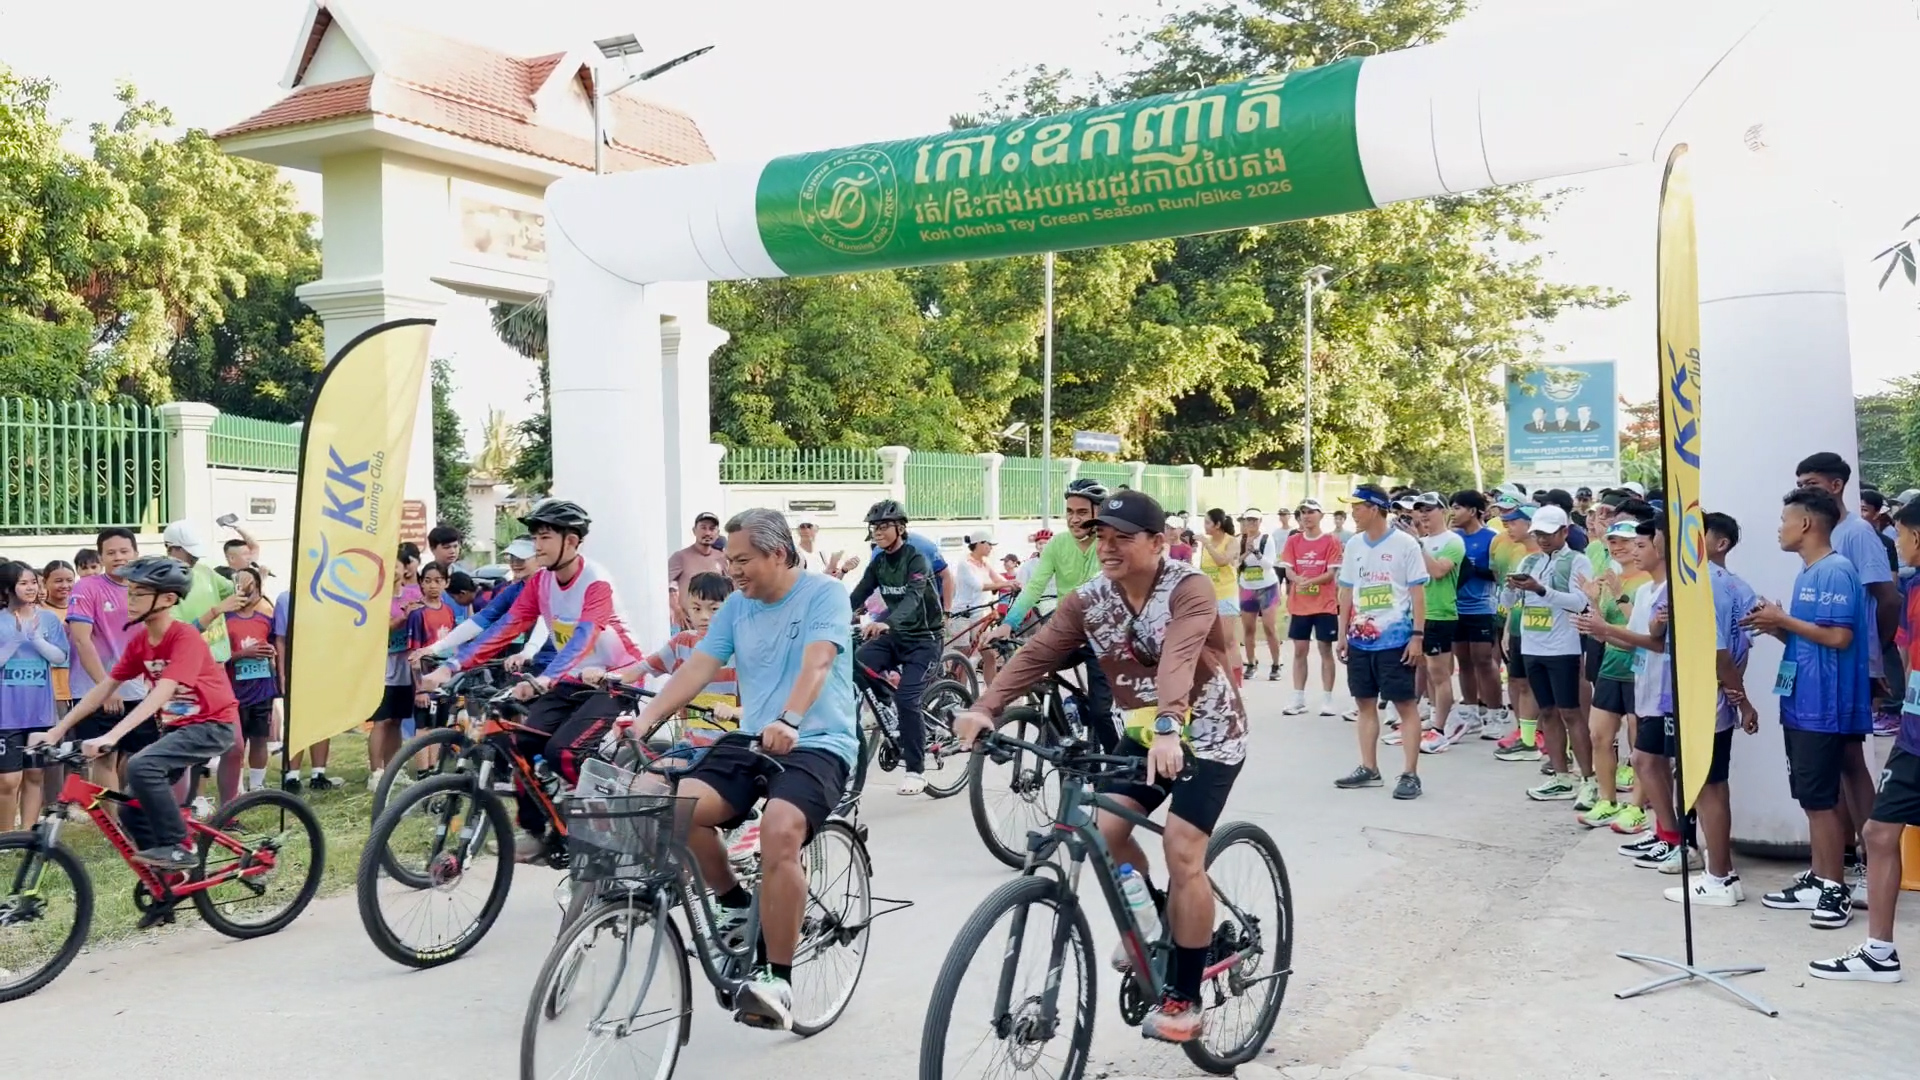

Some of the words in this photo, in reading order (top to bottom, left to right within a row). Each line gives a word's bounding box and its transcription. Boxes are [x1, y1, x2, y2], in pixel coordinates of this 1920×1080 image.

[919, 228, 951, 242] Koh
[953, 222, 1006, 239] Oknha
[1007, 218, 1036, 233] Tey
[1040, 211, 1089, 228] Green
[1092, 201, 1155, 220] Season
[1159, 188, 1242, 211] Run/Bike
[1245, 179, 1292, 198] 2026
[821, 233, 836, 246] KK
[838, 241, 876, 251] Running
[1667, 341, 1700, 470] KK
[321, 443, 371, 530] KK
[370, 450, 385, 480] Club
[365, 481, 384, 535] Running
[1832, 593, 1848, 605] KK
